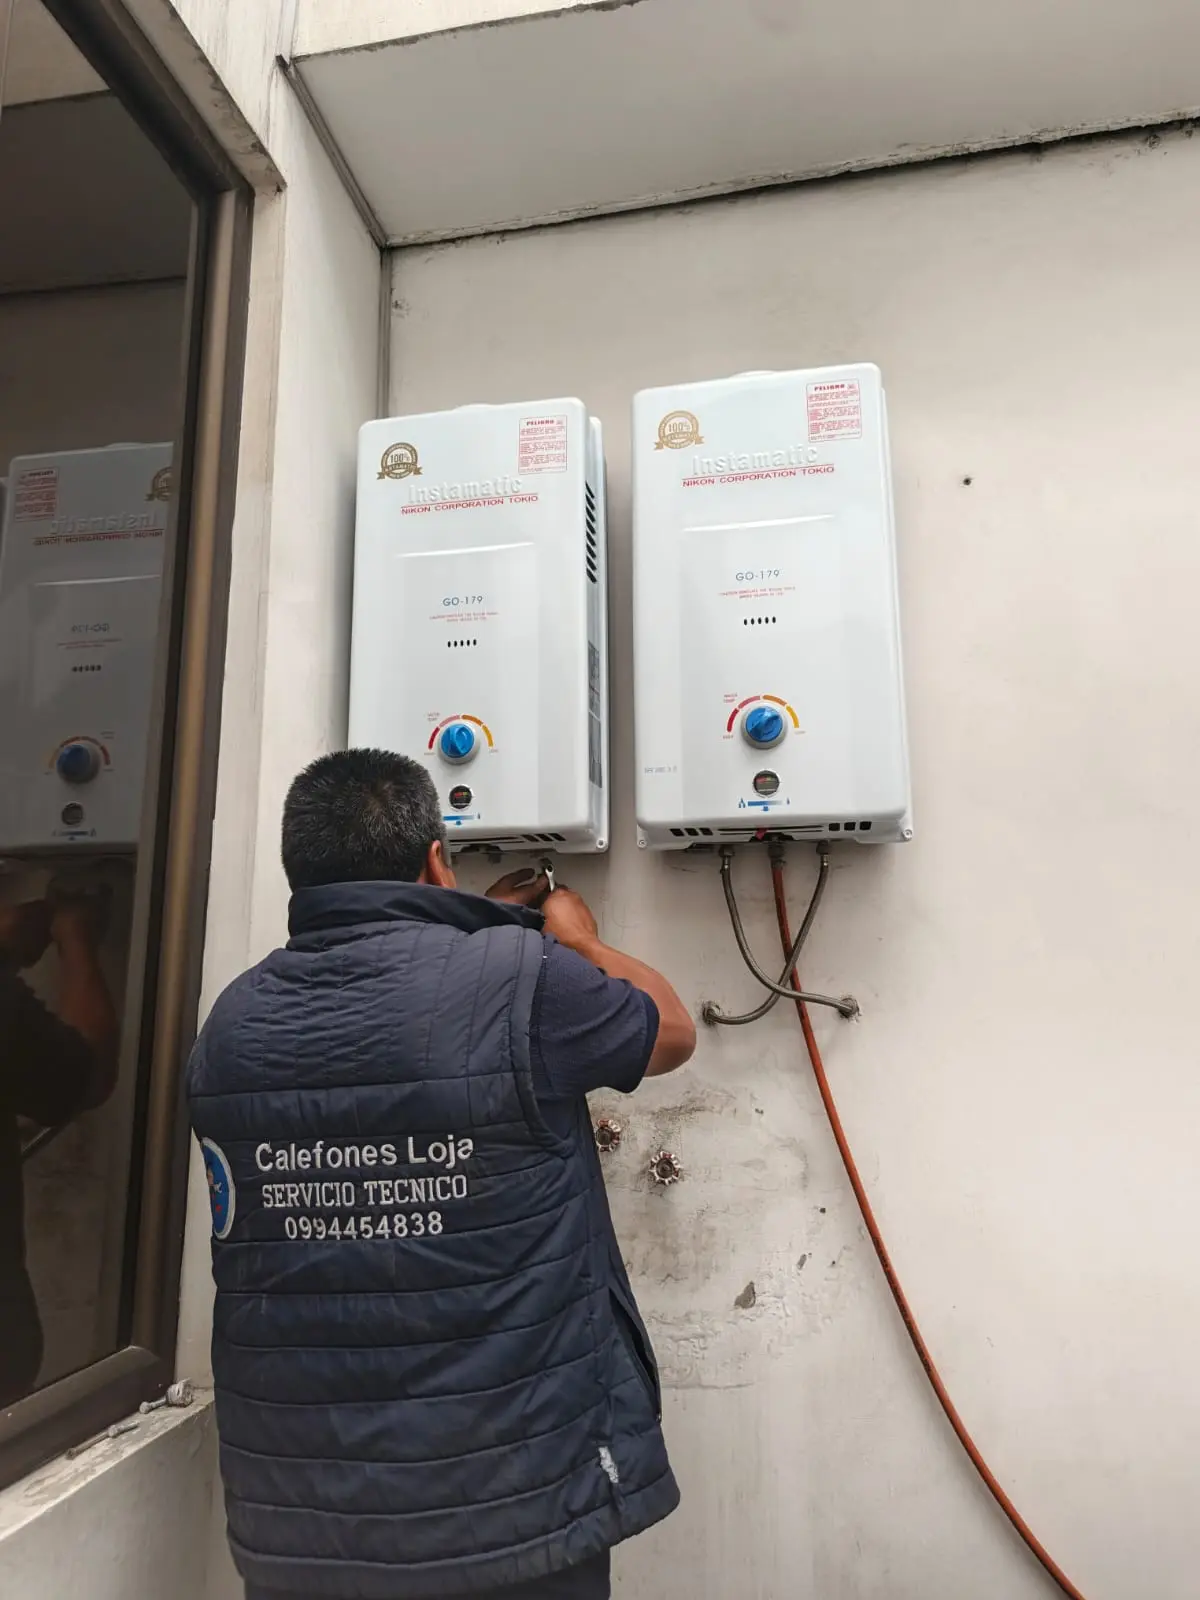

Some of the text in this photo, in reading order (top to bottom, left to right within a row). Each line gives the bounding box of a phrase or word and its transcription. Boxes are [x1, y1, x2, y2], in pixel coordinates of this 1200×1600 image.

[692, 444, 819, 475] Instamatic
[408, 474, 523, 504] Instamatic
[682, 466, 835, 488] NIKON CORPORATION TOKIO
[401, 495, 539, 515] NIKON CORPORATION TOKIO
[735, 569, 780, 581] GO-179
[442, 595, 483, 607] GO-179
[255, 1134, 474, 1172] Calefones Loja
[262, 1174, 468, 1208] SERVICIO TECNICO
[284, 1211, 443, 1241] 0994454838
